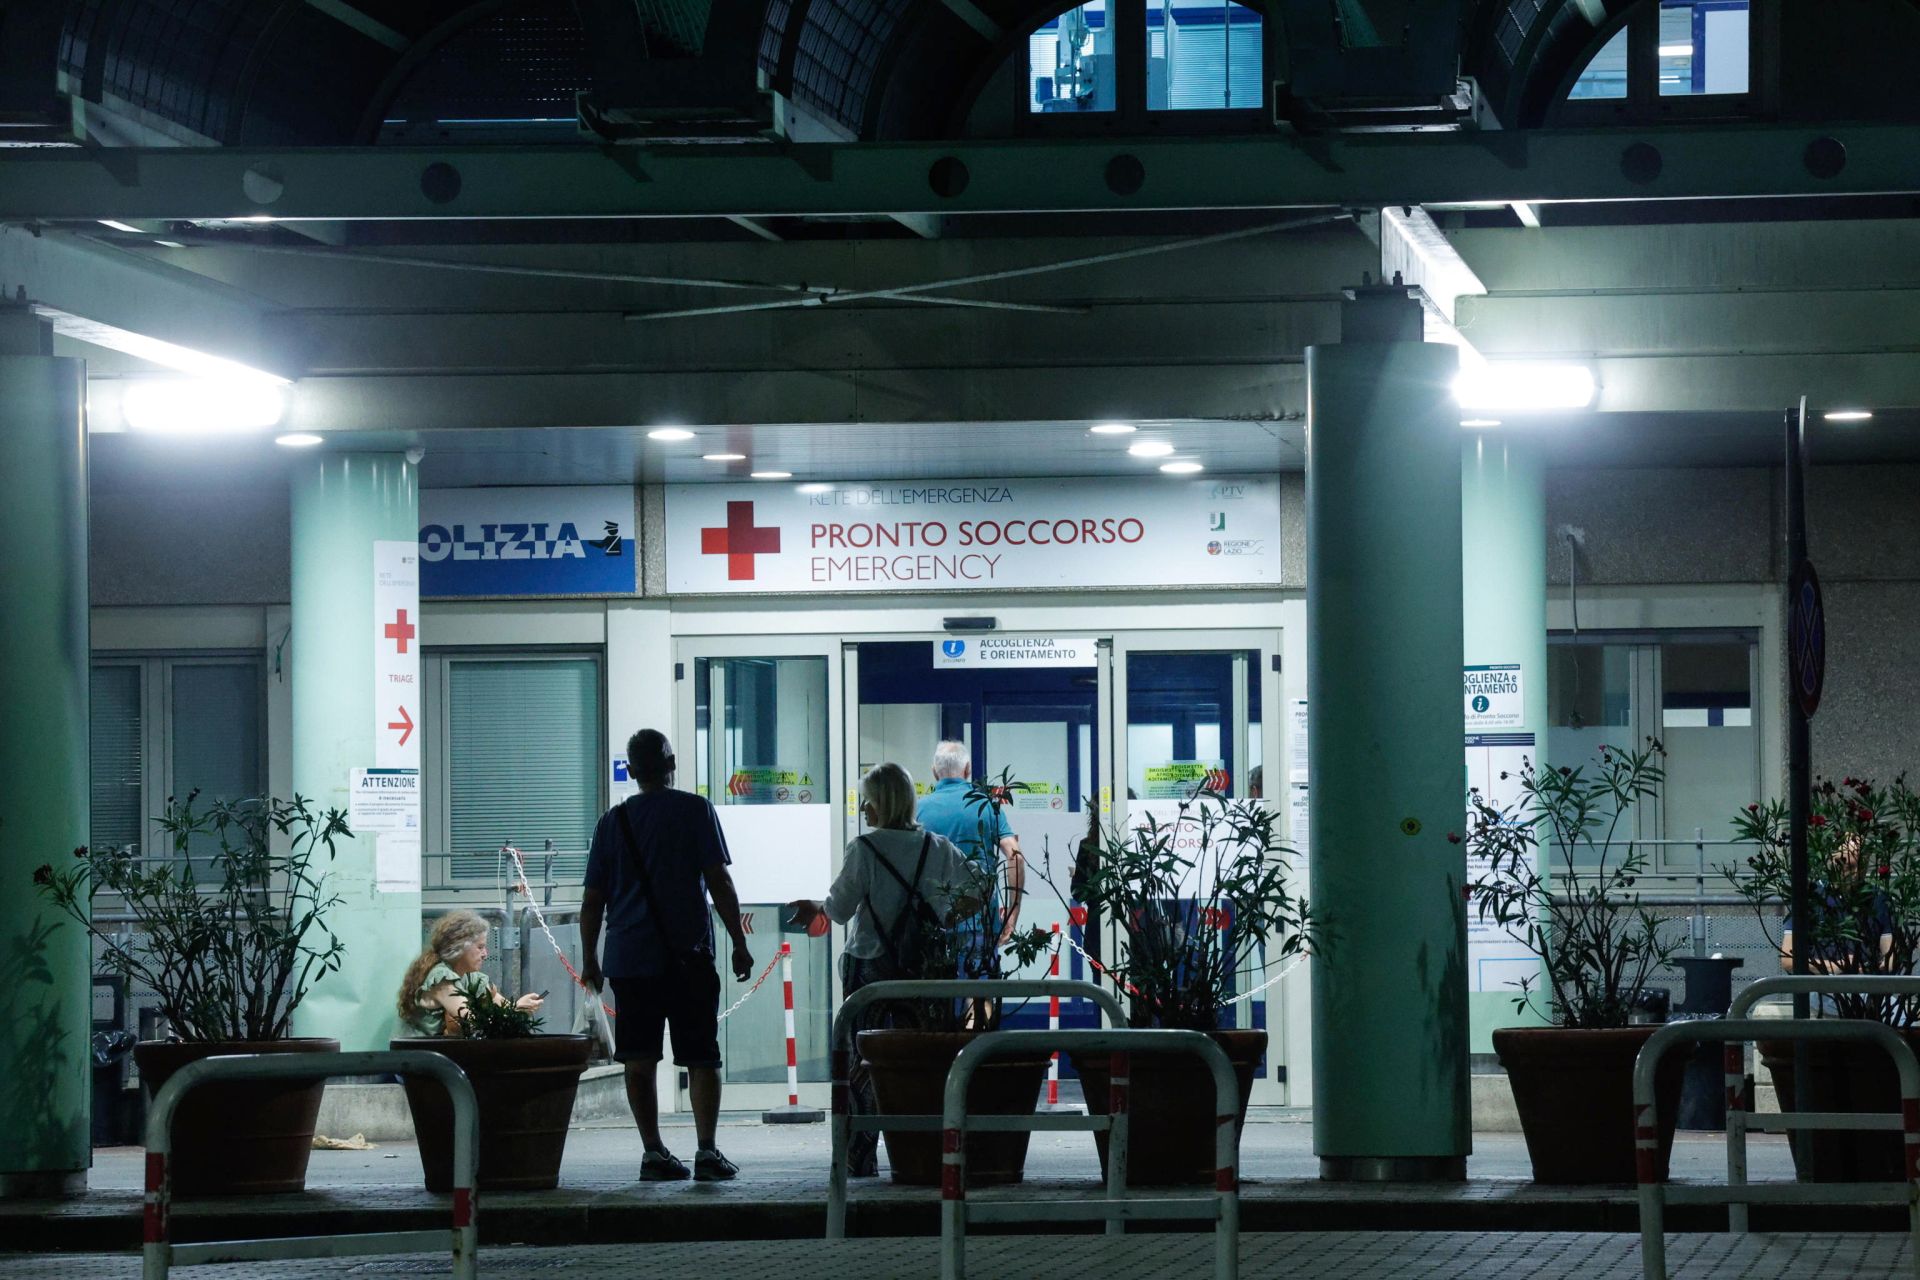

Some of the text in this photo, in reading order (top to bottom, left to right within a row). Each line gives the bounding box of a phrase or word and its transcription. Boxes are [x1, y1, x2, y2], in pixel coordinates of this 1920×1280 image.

[809, 487, 1014, 506] RETE DELL'EMERGENZA
[811, 517, 1145, 548] PRONTO SOCCORSO
[811, 553, 1002, 582] EMERGENCY
[979, 638, 1055, 648] ACCOGLIENZA
[980, 649, 1076, 660] E ORIENTAMENTO
[388, 674, 414, 683] TRIAGE
[1511, 674, 1517, 683] e
[1464, 683, 1518, 694] NTAMENTO
[361, 777, 415, 788] ATTENZIONE
